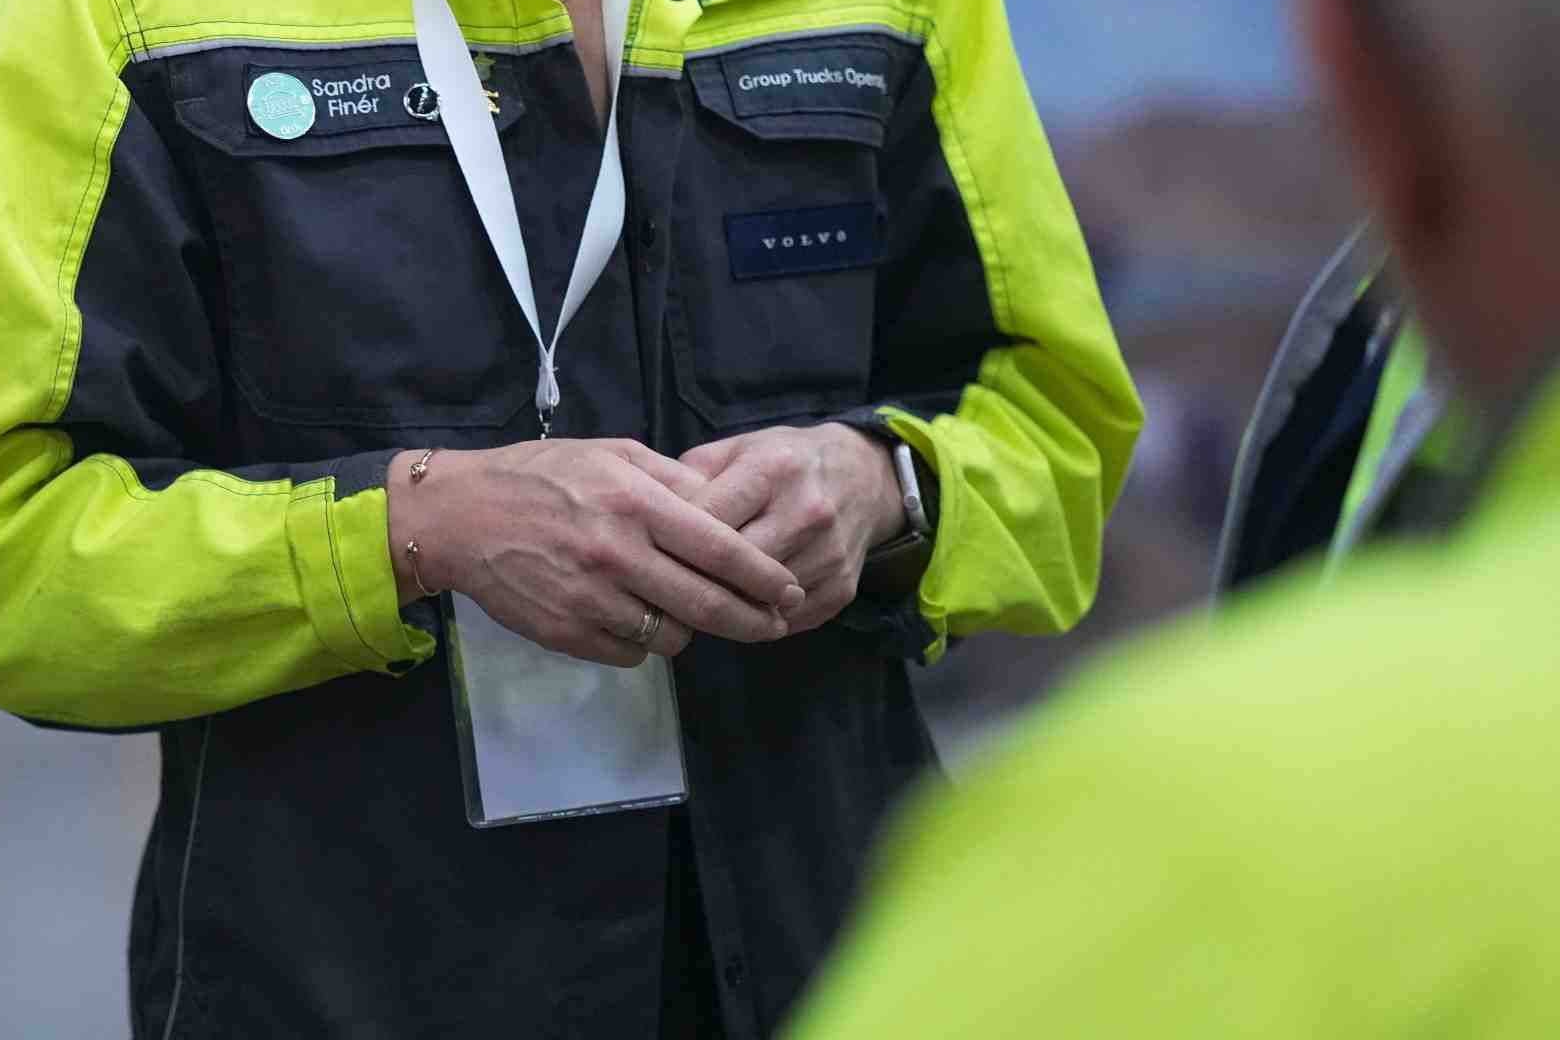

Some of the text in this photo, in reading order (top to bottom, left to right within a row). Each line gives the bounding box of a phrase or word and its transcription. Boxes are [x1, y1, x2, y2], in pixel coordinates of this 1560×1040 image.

[311, 73, 391, 98] Sandra
[738, 69, 792, 91] Group
[793, 68, 843, 85] Trucks
[327, 94, 380, 118] Finér
[761, 229, 848, 249] VOLVO
